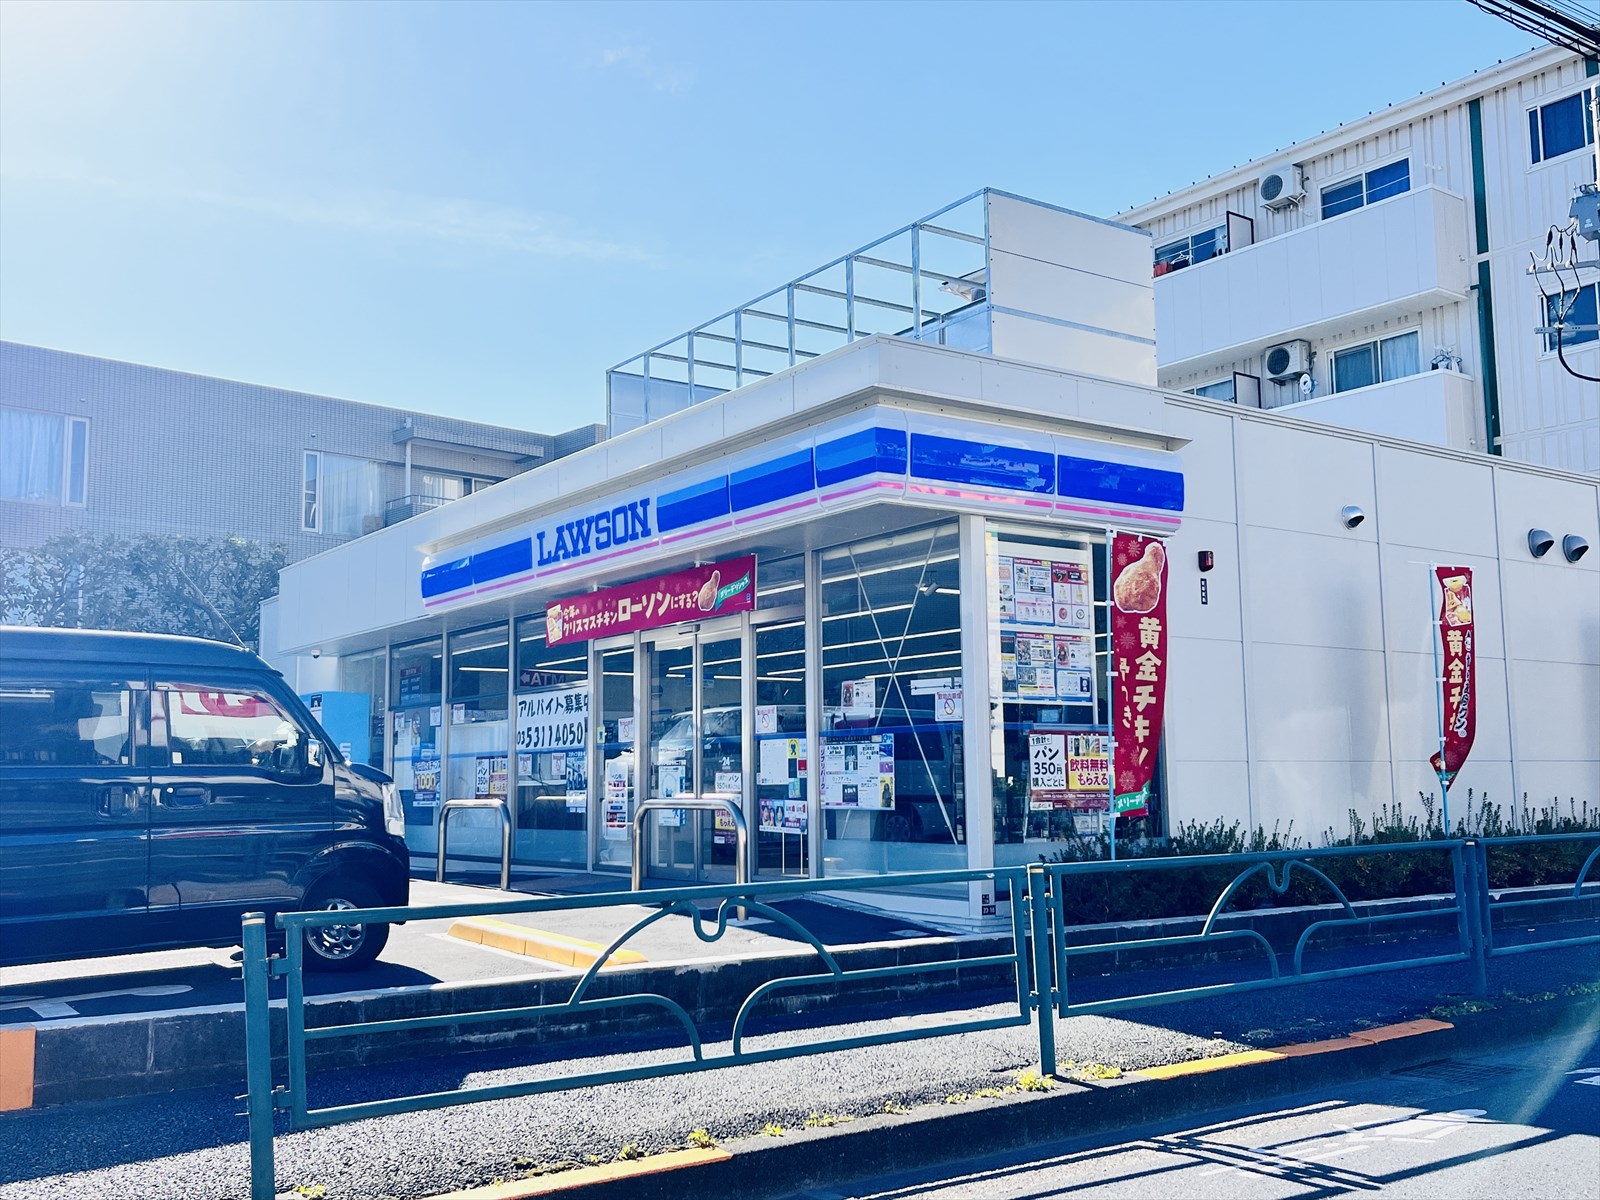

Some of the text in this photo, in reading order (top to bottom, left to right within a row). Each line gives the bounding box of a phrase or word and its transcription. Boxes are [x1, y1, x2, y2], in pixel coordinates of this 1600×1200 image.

[537, 498, 651, 566] LAWSON
[563, 605, 580, 621] 今年の
[563, 590, 698, 637] クリスマスチキン ローソンにする?
[530, 672, 565, 686] ATM
[1034, 747, 1059, 760] パン
[1034, 762, 1063, 775] 350円
[1070, 758, 1112, 772] 飲料無料
